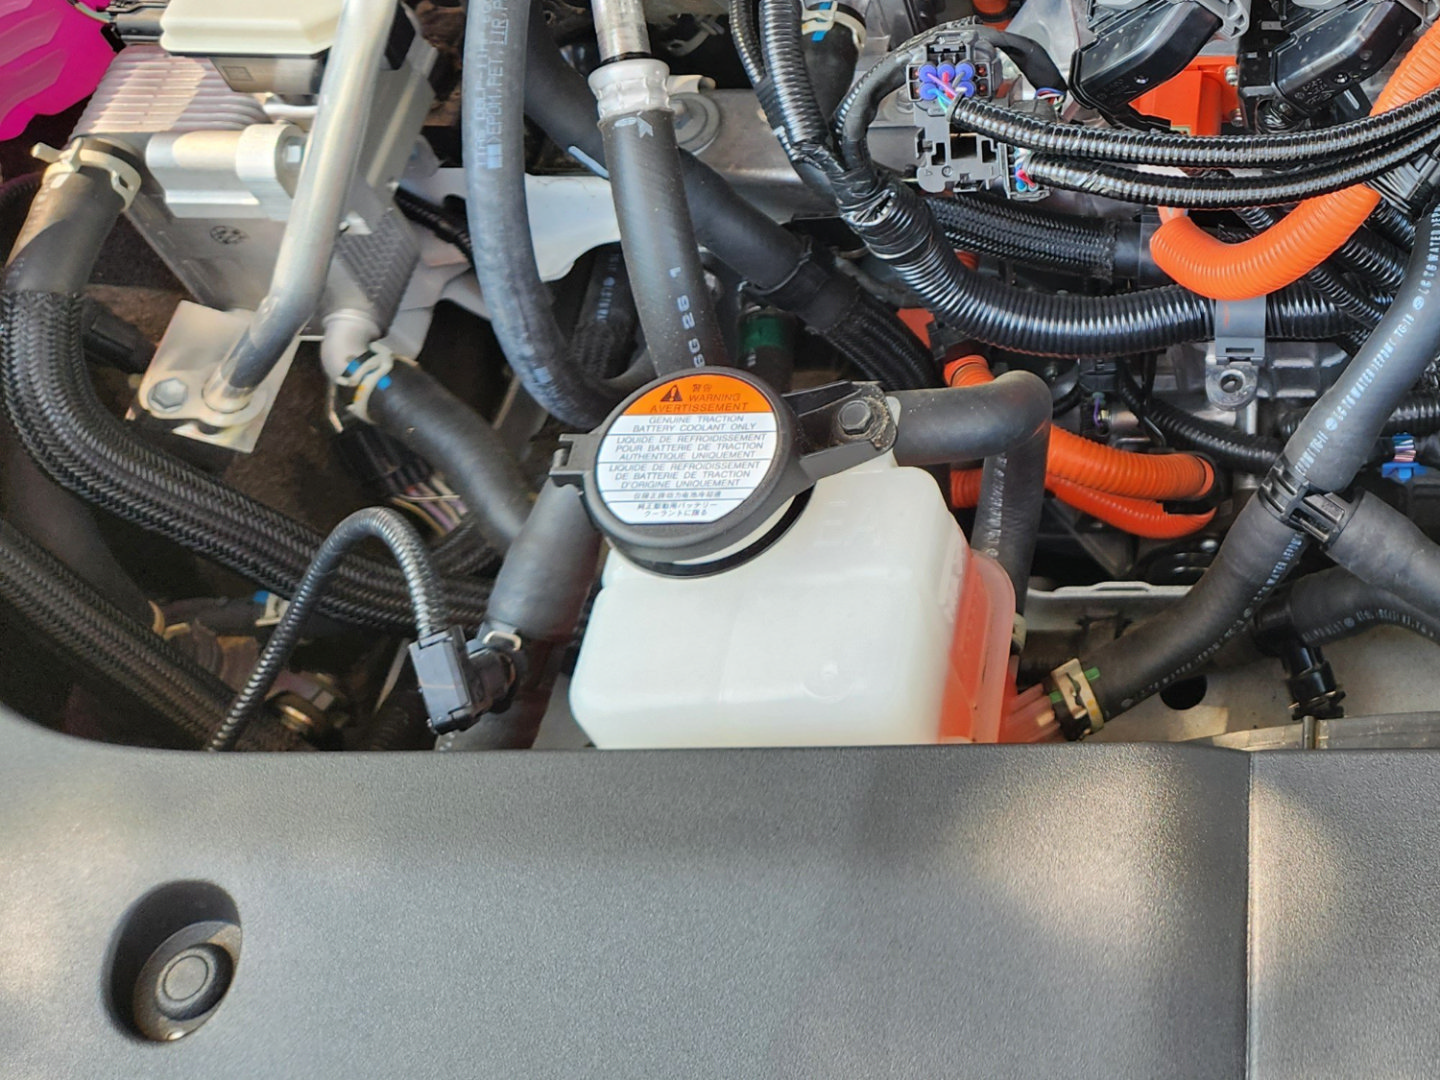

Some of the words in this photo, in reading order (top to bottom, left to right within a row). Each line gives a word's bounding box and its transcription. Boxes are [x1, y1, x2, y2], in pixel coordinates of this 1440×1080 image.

[1350, 368, 1375, 399] WATER
[689, 393, 741, 401] WARNING
[650, 402, 749, 413] AVERTISSEMENT
[649, 416, 693, 424] GENUINE
[697, 415, 744, 423] TRACTION
[632, 424, 674, 432] BATTERY
[680, 423, 726, 431] COOLANT
[730, 422, 757, 430] ONLY
[617, 435, 656, 444] LIQUIDE
[659, 435, 673, 443] DE
[677, 434, 767, 443] REFROIDISSEMENT
[615, 444, 643, 452] POUR
[648, 444, 692, 452] BATTERIE
[697, 443, 713, 451] DE
[717, 443, 764, 451] TRACTION
[619, 452, 690, 460] AUTHENTIQUE
[692, 451, 756, 459] UNIQUEMENT
[609, 463, 650, 472] LIQUIDE
[652, 463, 666, 471] DE
[670, 462, 760, 471] REFROIDISSEMENT
[615, 472, 630, 480] DE
[633, 471, 678, 480] BATTERIE
[684, 471, 699, 479] DE
[703, 470, 750, 479] TRACTION
[621, 480, 674, 489] D'ORIGINE
[676, 479, 741, 488] UNIQUEMENT
